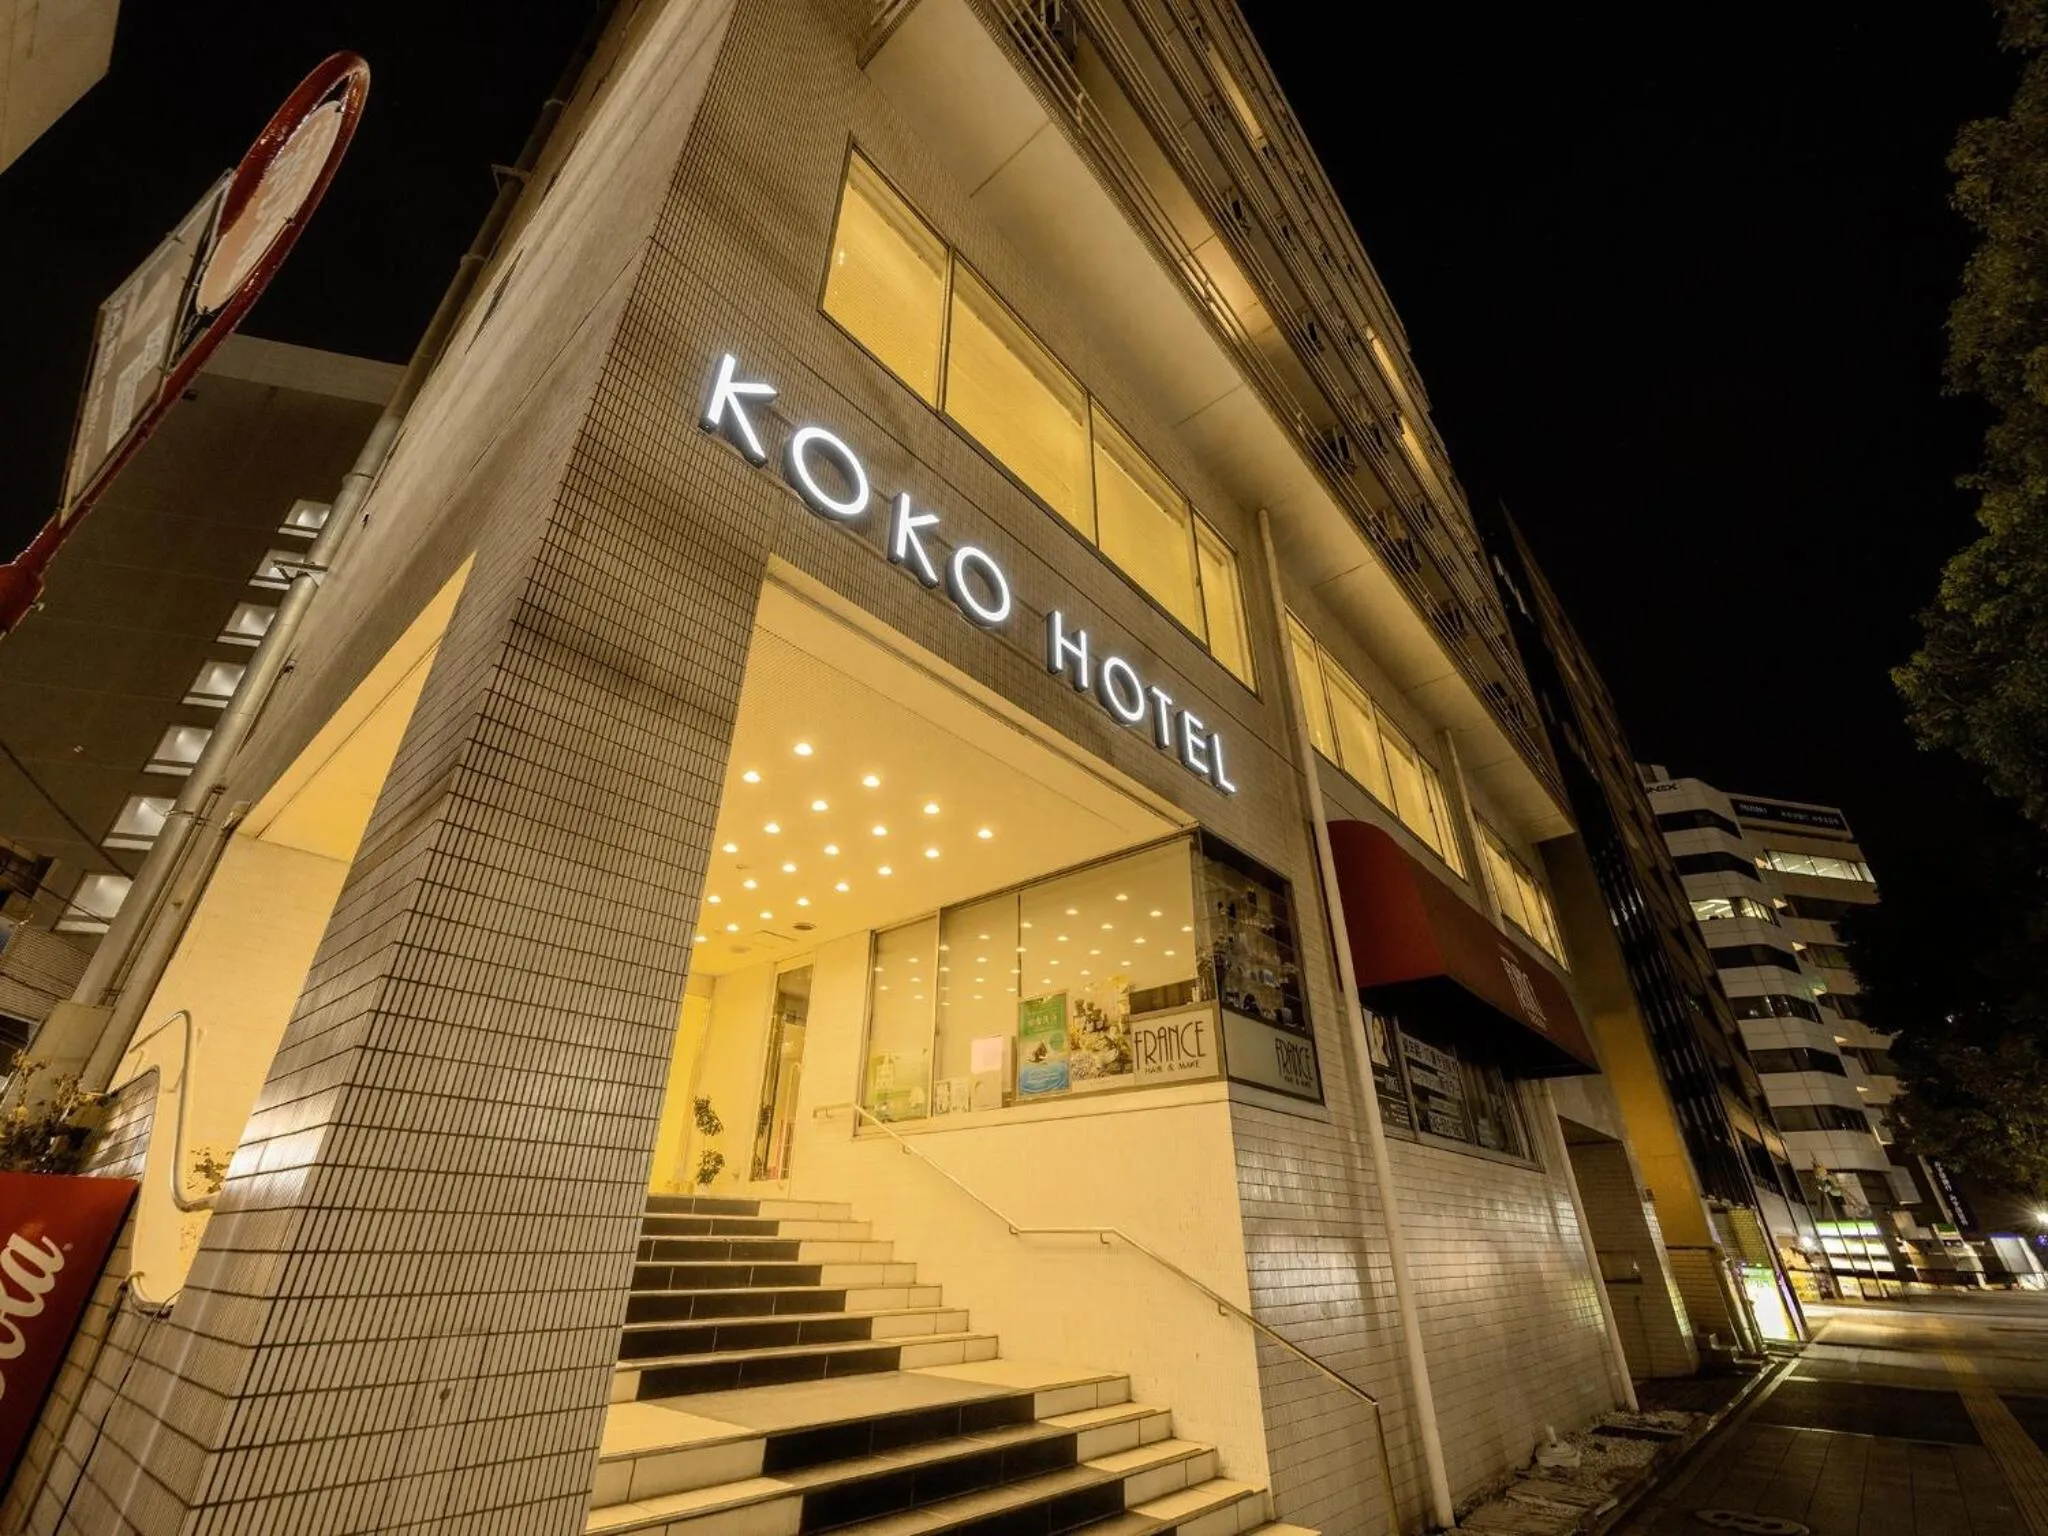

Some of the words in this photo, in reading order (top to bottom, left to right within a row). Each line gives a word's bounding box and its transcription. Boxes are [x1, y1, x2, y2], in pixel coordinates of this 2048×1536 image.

[700, 353, 1012, 626] KOKO
[1048, 610, 1236, 796] HOTEL
[1133, 1021, 1205, 1071] FRANCE
